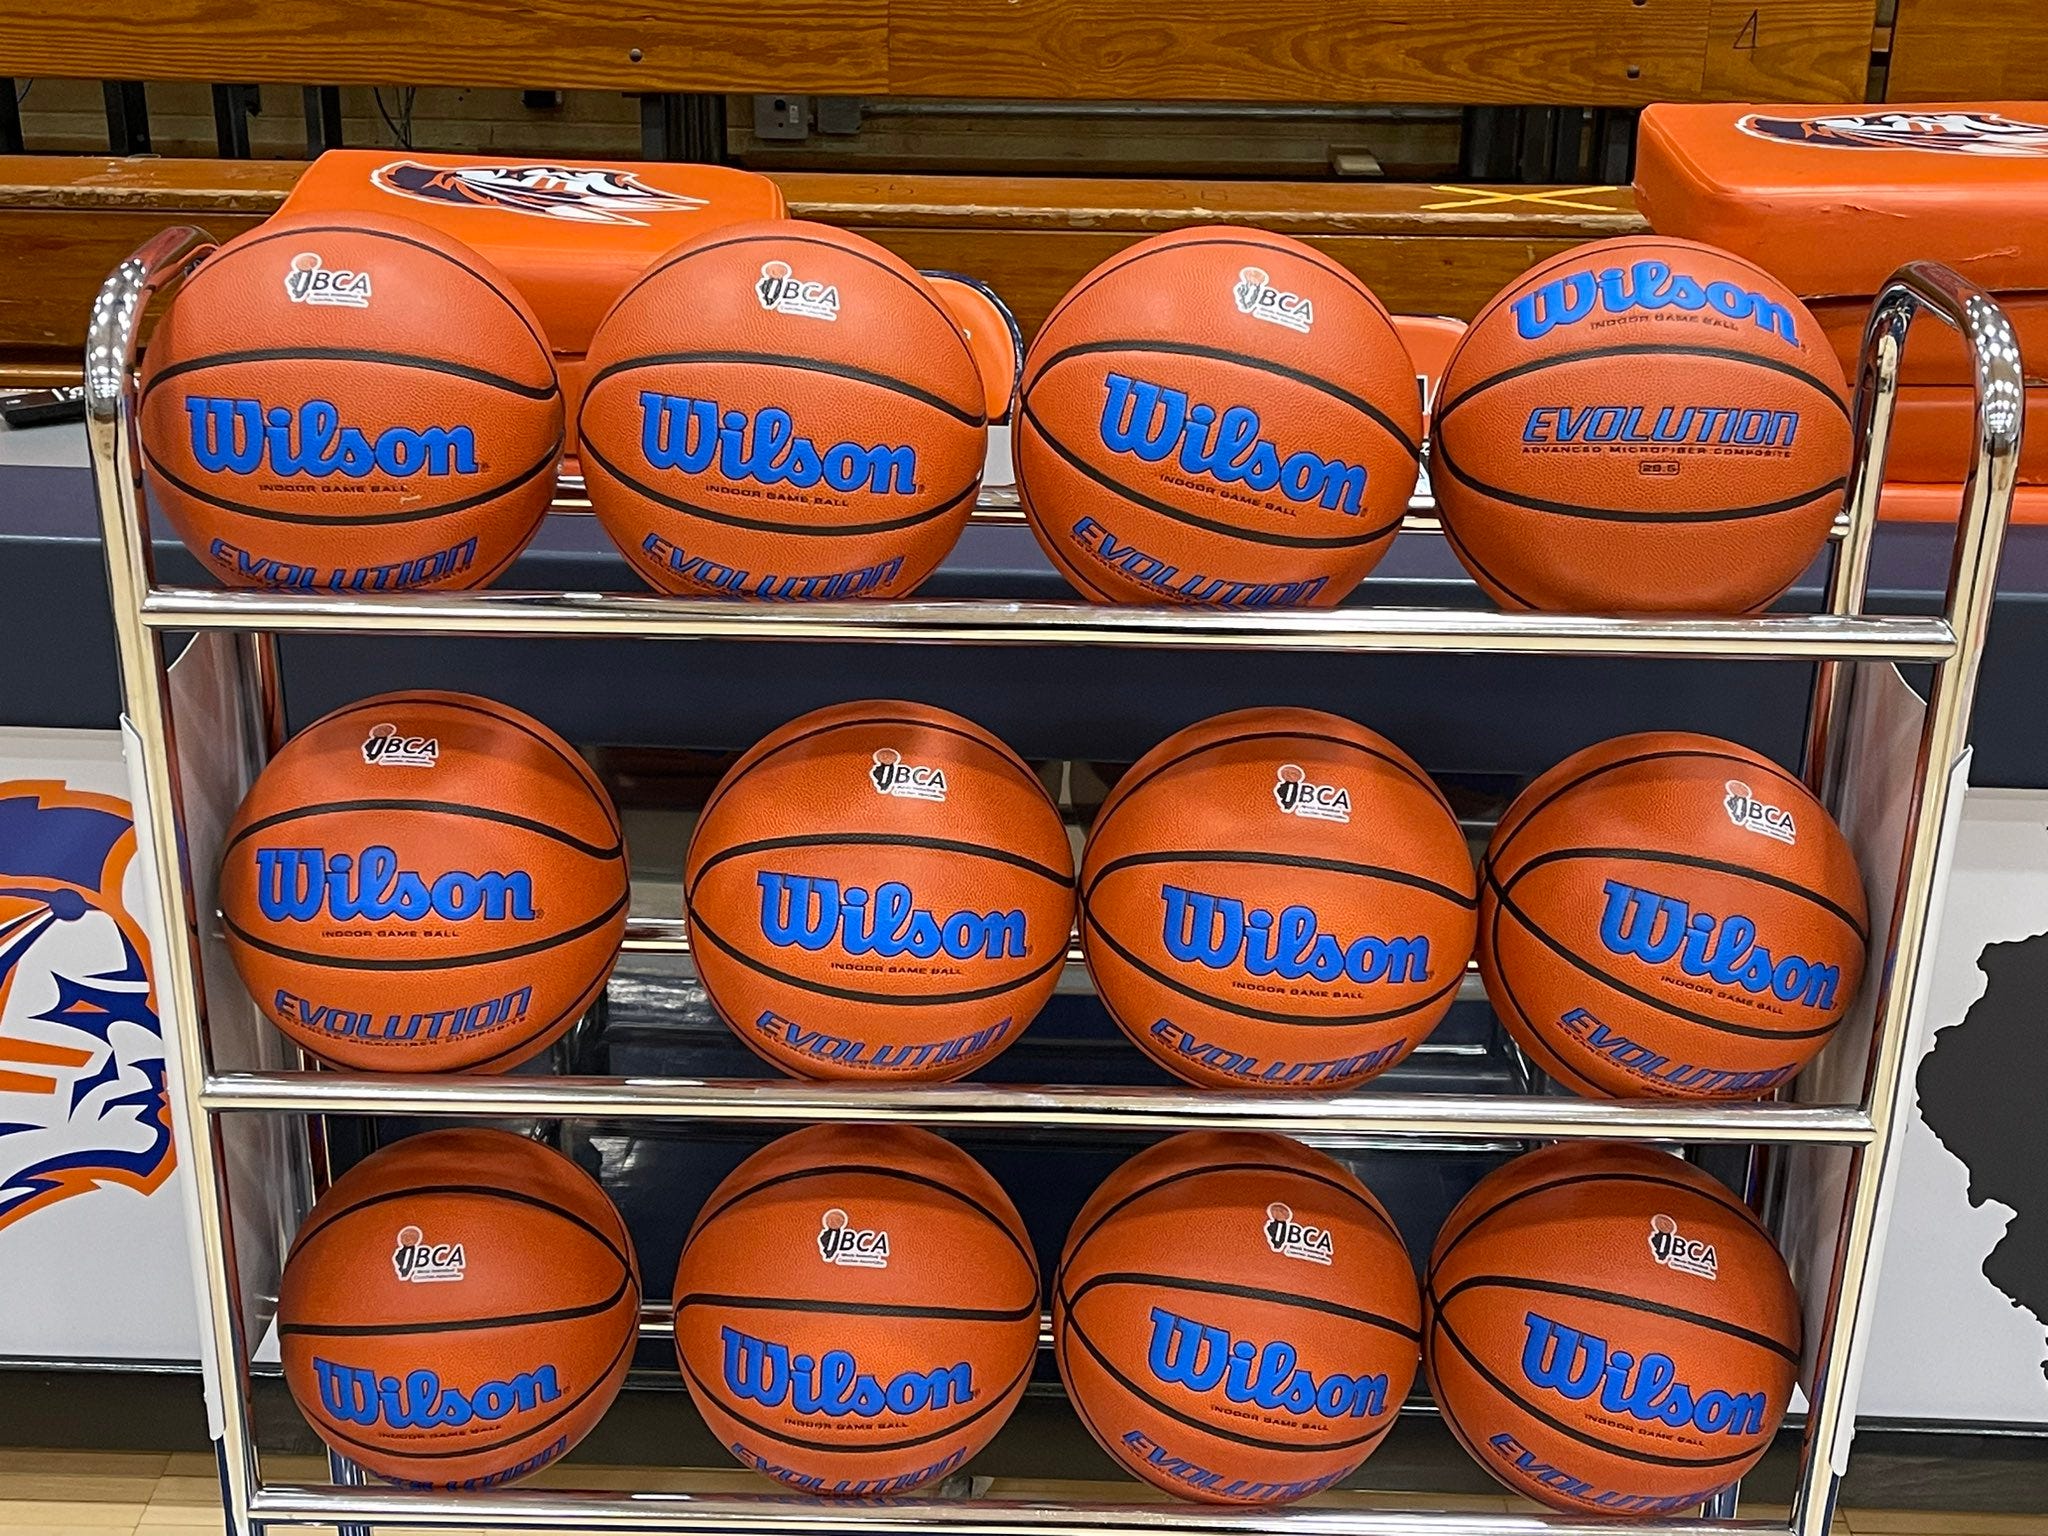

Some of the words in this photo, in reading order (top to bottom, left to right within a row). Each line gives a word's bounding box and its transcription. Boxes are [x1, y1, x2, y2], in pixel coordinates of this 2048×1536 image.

[1510, 261, 1800, 348] Wilson
[185, 396, 479, 478] Wilson
[639, 391, 917, 495] Wilson
[1100, 373, 1367, 516] Wilson
[1521, 406, 1799, 447] EVOLUTION
[259, 484, 317, 494] INDOOR
[321, 485, 366, 494] GAME
[370, 485, 410, 494] BALL
[705, 485, 761, 499] INDOOR
[766, 494, 809, 504] GAME
[814, 497, 849, 508] BALL
[1160, 474, 1216, 494] INDOOR
[1220, 490, 1260, 507] GAME
[1265, 502, 1298, 518] BALL
[1072, 516, 1330, 606] EVOLUTION
[256, 845, 536, 922] Wilson
[757, 871, 1027, 960] Wilson
[322, 930, 374, 938] INDOOR
[377, 930, 418, 938] GAME
[423, 930, 460, 938] BALL
[831, 962, 884, 972] INDOOR
[888, 965, 927, 975] GAME
[931, 967, 963, 976] BALL
[1161, 884, 1430, 984] Wilson
[1599, 880, 1840, 1011] Wilson
[274, 985, 532, 1041] EVOLUTION
[1232, 981, 1286, 994] INDOOR
[1289, 988, 1329, 998] GAME
[1332, 991, 1364, 1000] BALL
[1660, 975, 1713, 995] INDOOR
[1717, 991, 1753, 1007] GAME
[1756, 1002, 1785, 1015] BALL
[756, 1010, 1012, 1067] EVOLUTION
[1150, 1018, 1407, 1081] EVOLUTION
[313, 1357, 561, 1429] Wilson
[721, 1325, 973, 1417] Wilson
[1148, 1307, 1389, 1418] Wilson
[1521, 1312, 1766, 1435] Wilson
[1210, 1405, 1259, 1422] INDOOR
[1263, 1415, 1299, 1428] GAME
[1301, 1421, 1330, 1432] BALL
[1489, 1433, 1727, 1511] EVOLUT
